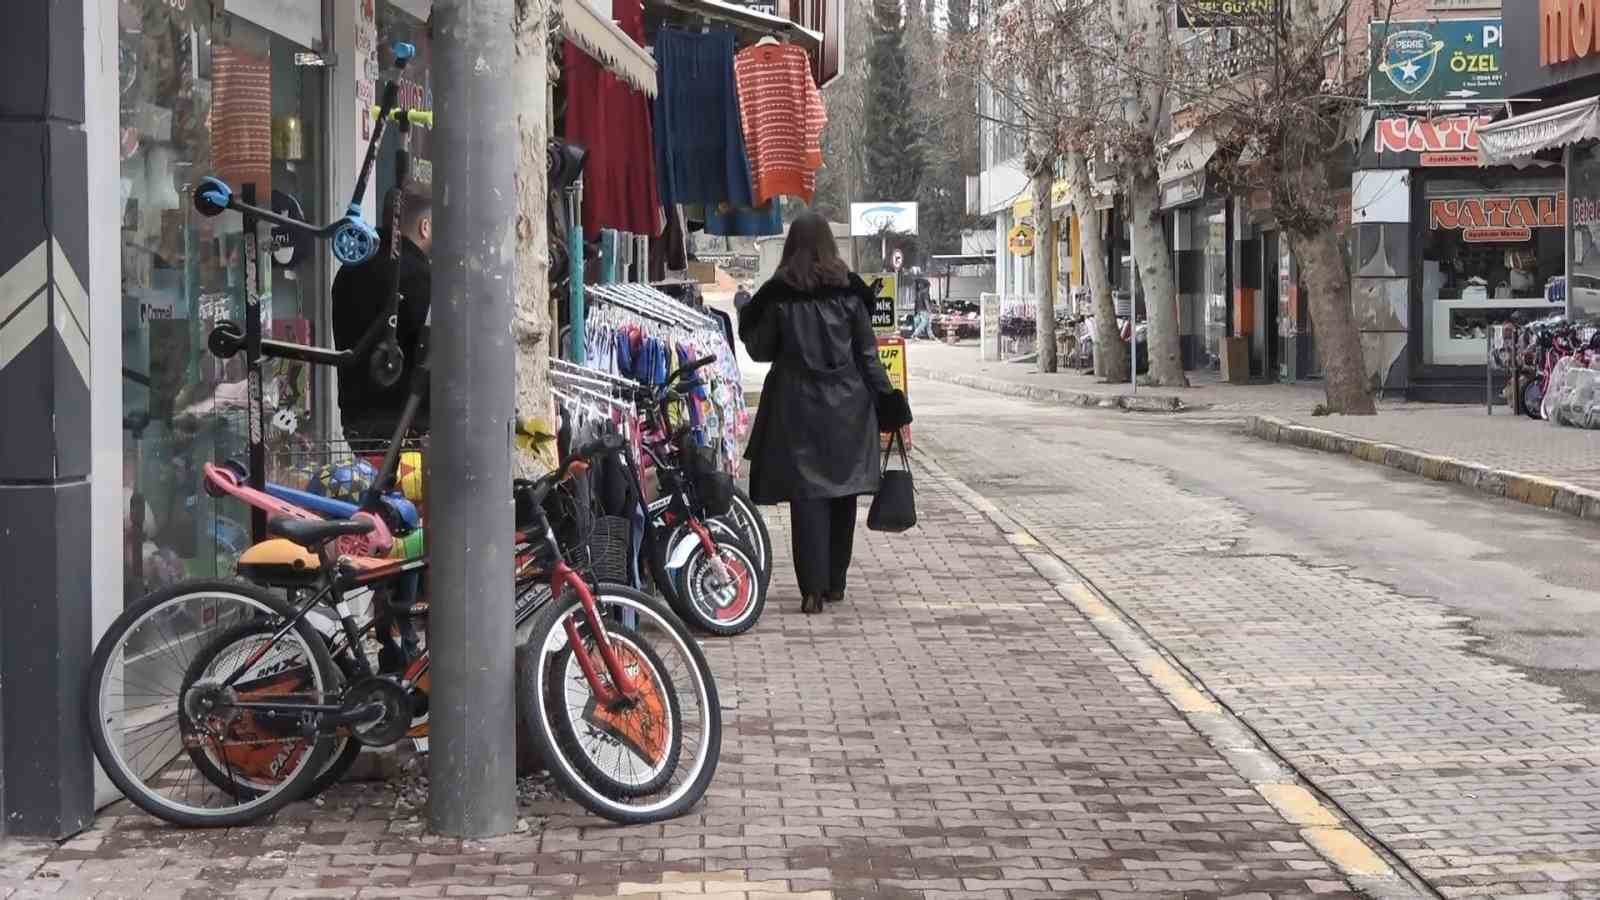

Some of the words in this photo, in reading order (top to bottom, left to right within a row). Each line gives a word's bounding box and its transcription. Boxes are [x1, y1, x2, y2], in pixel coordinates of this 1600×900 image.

[1482, 25, 1502, 48] P
[1539, 0, 1600, 66] mo
[1450, 51, 1499, 72] ÖZEL
